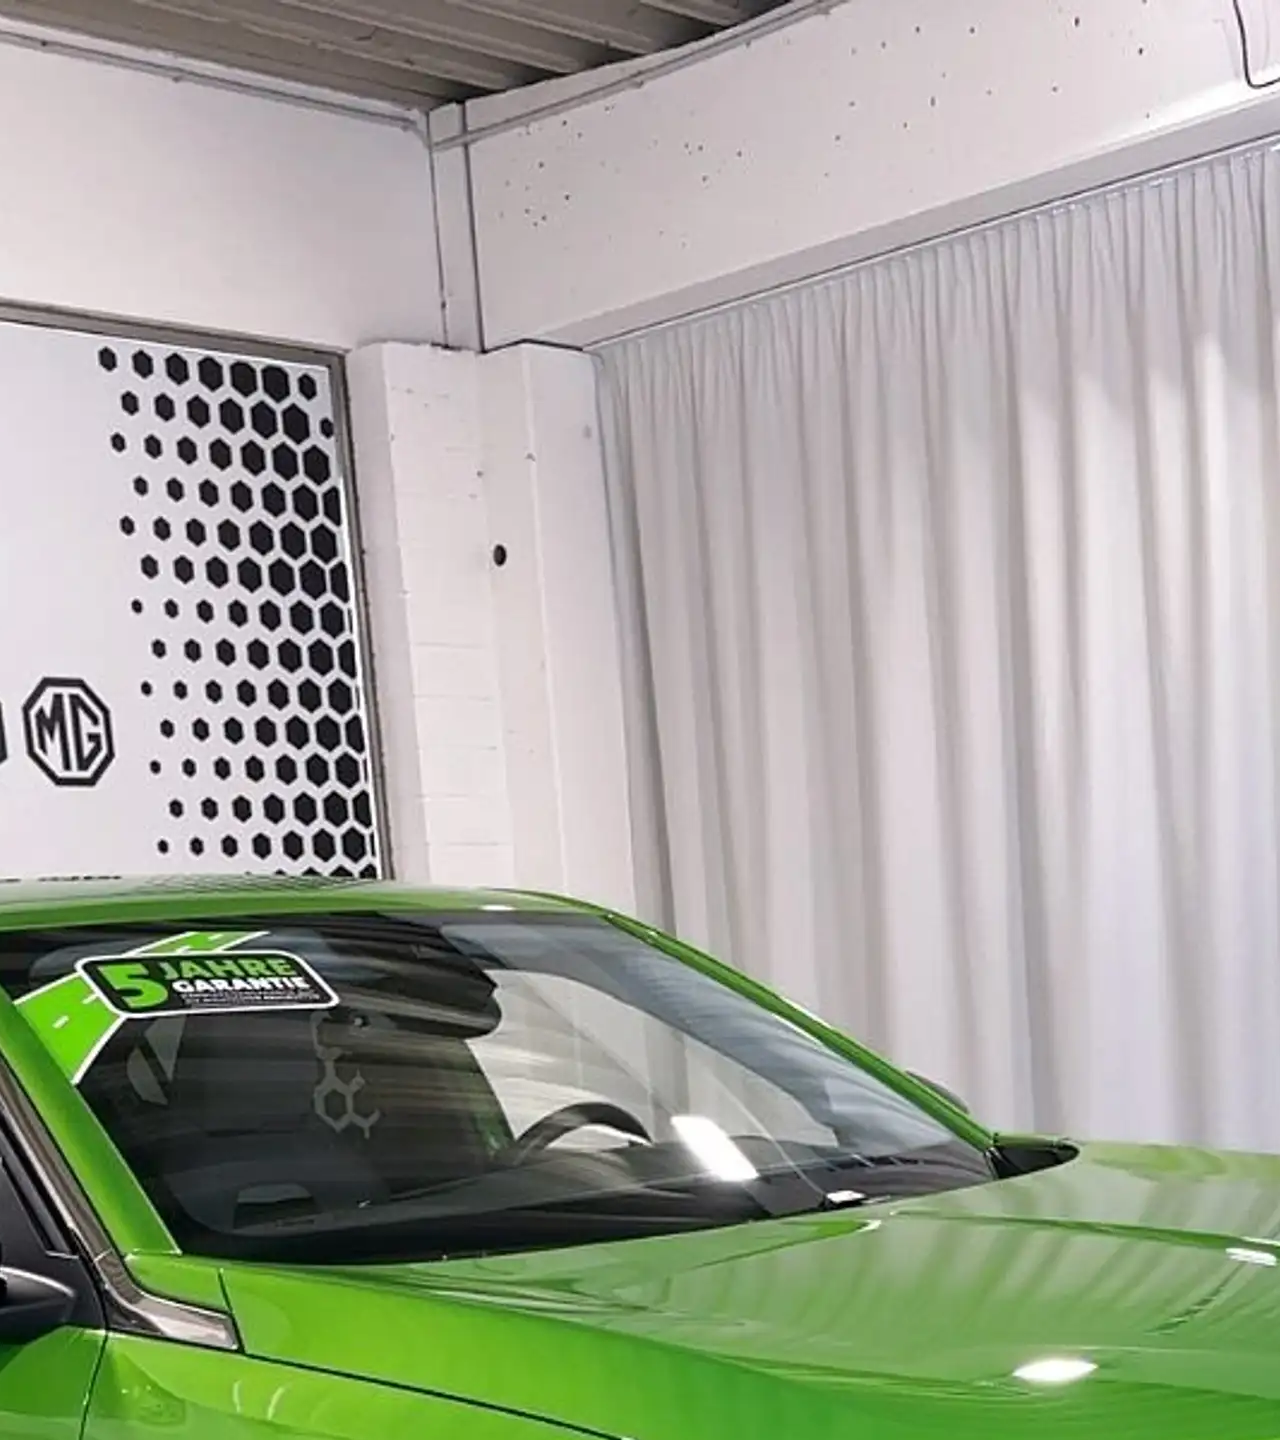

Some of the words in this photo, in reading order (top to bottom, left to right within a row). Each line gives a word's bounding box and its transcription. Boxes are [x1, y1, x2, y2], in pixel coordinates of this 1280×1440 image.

[32, 690, 105, 774] MG
[97, 962, 169, 1010] 5
[159, 957, 298, 980] JAHRE
[171, 976, 311, 994] GARANTIE
